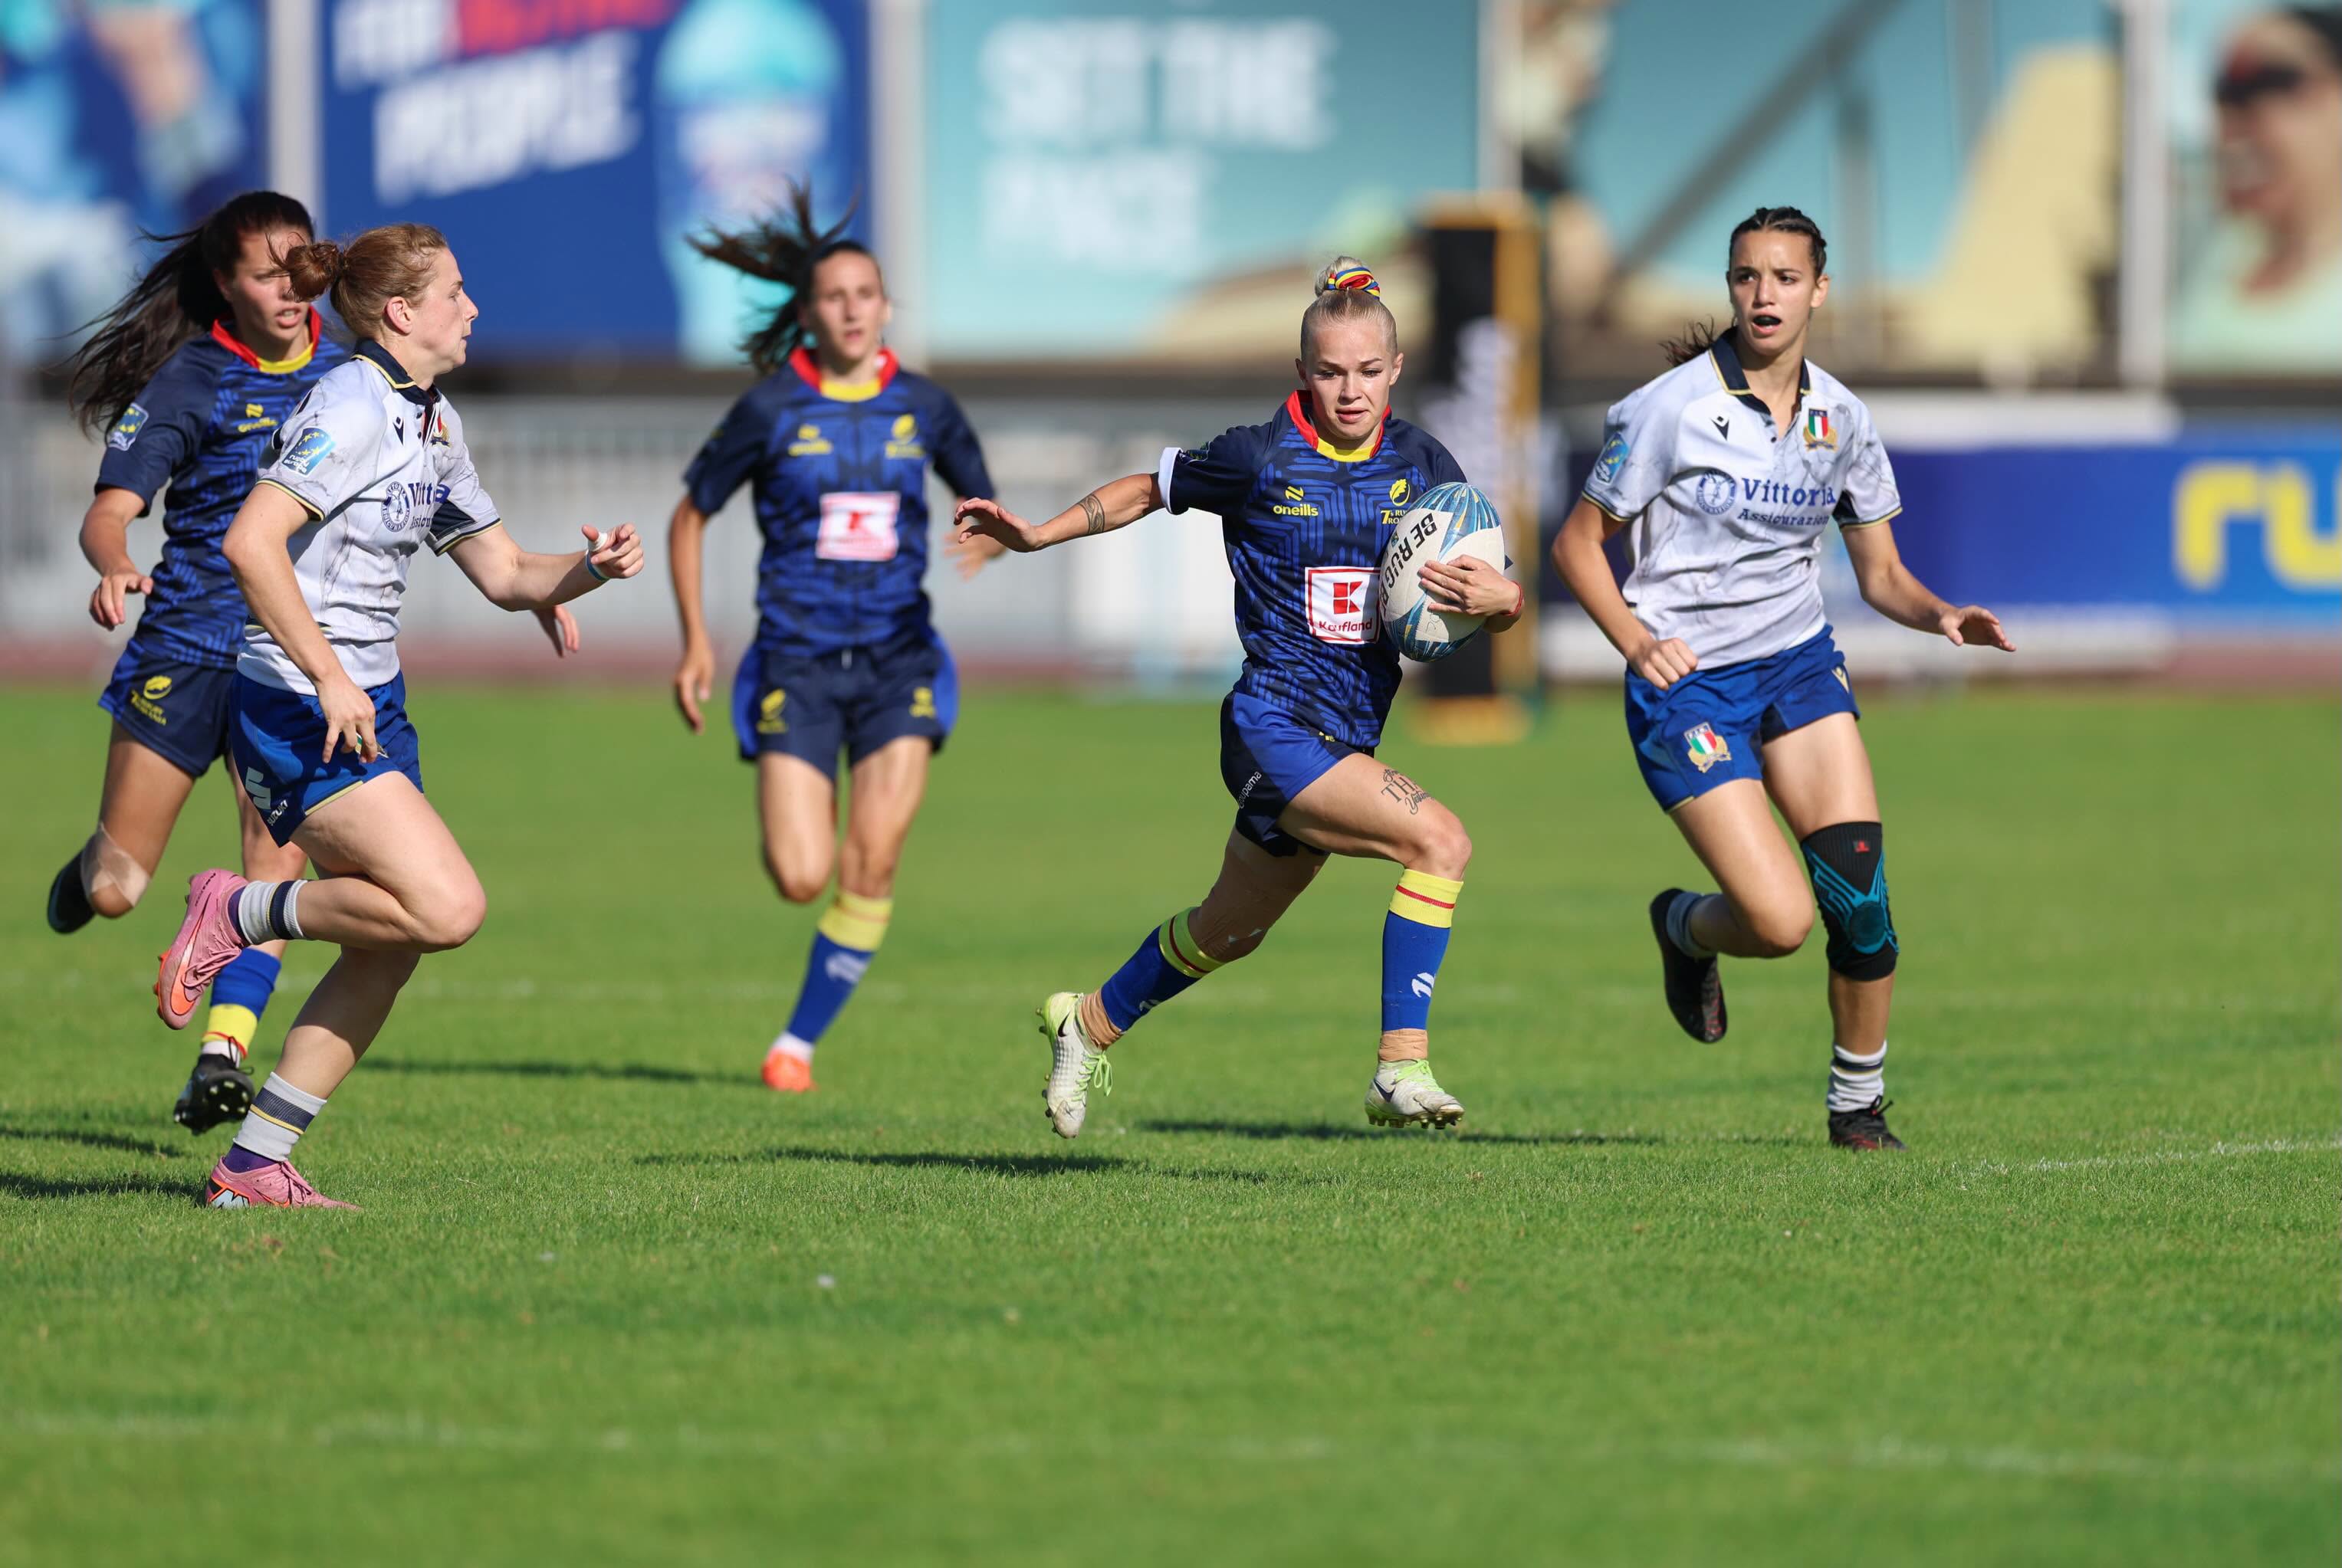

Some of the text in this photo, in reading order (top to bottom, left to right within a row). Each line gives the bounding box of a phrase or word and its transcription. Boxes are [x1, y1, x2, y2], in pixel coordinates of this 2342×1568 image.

[1159, 17, 1338, 147] THE
[1742, 477, 1836, 507] Vittoria
[1410, 512, 1438, 549] BE
